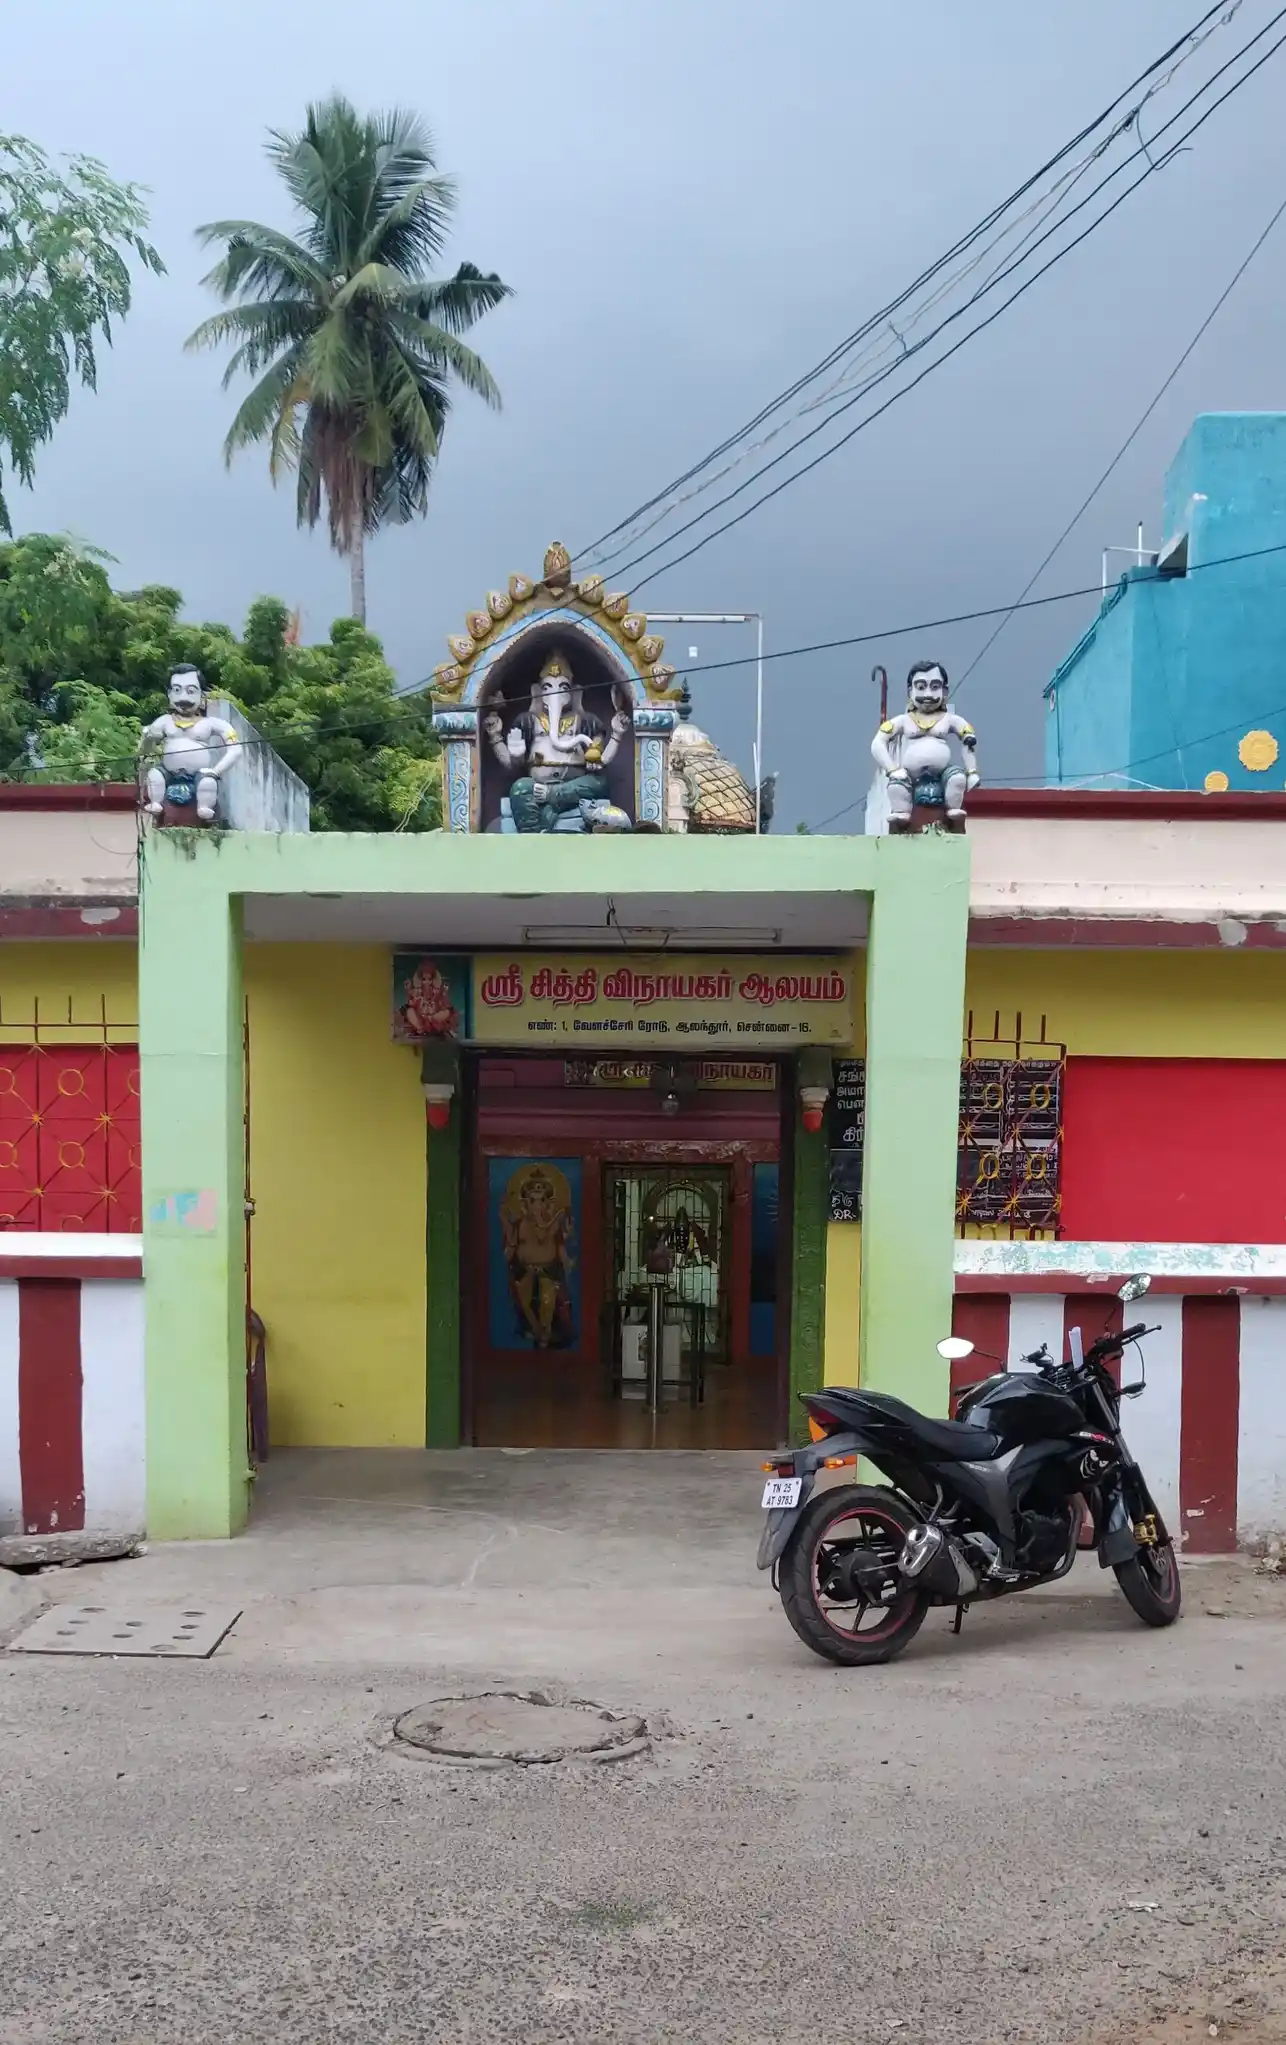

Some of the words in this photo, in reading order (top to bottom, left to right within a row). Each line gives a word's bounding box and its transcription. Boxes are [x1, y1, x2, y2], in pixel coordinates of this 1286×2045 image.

[481, 963, 524, 1007] ஸ்ரீ
[530, 967, 598, 1009] சித்தி
[602, 967, 733, 1009] விநாயகர்
[738, 969, 848, 1007] ஆலயம்
[573, 1019, 634, 1031] வேளச்சேரி
[772, 1483, 782, 1493] TN
[783, 1483, 793, 1493] 25
[766, 1495, 776, 1506] AT
